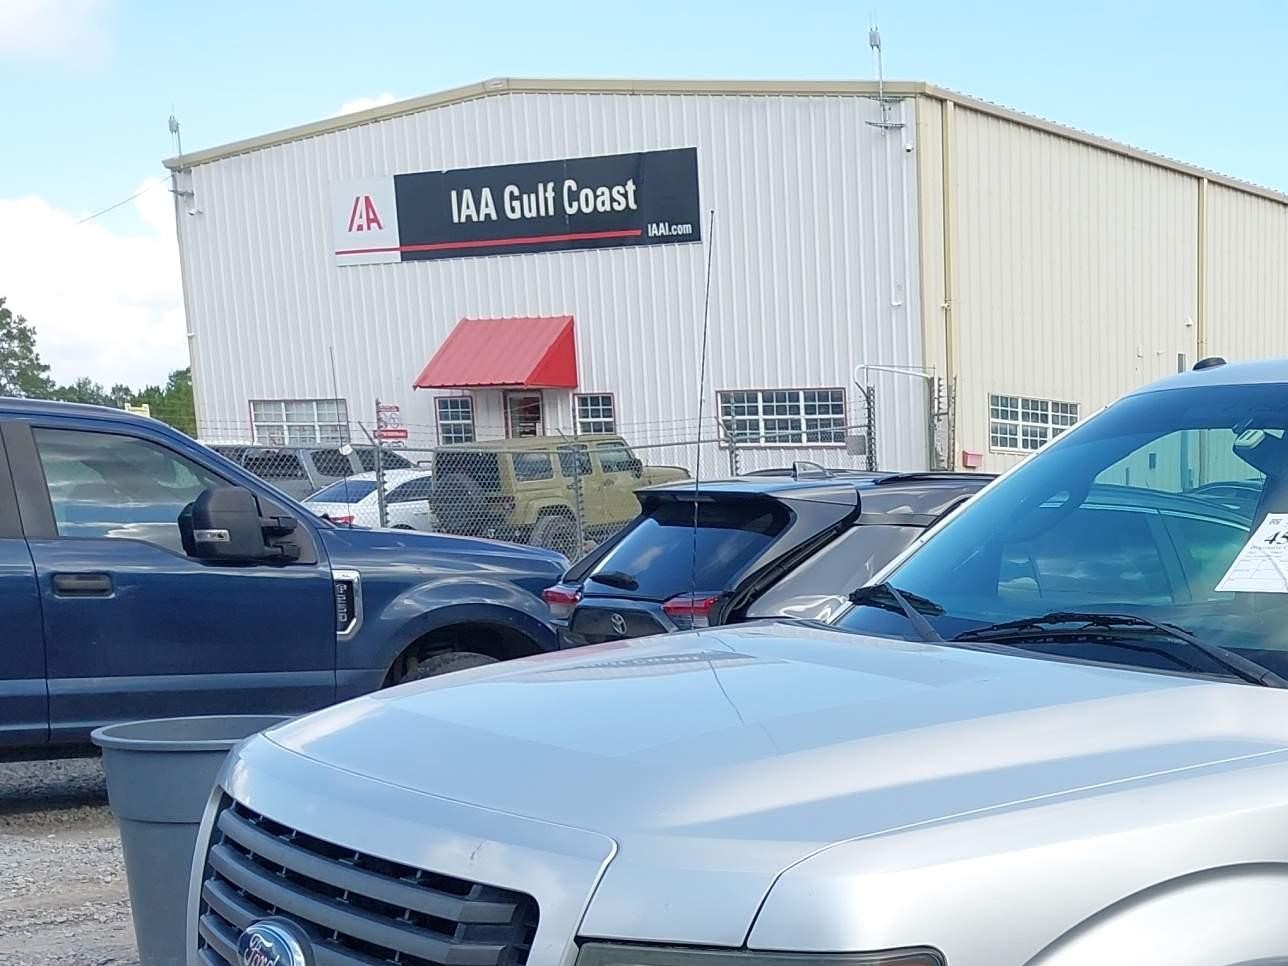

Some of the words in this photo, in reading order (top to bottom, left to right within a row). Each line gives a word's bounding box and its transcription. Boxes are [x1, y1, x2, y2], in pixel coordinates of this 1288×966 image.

[451, 187, 498, 224] IAA
[504, 181, 555, 220] Gulf
[563, 178, 638, 215] Coast
